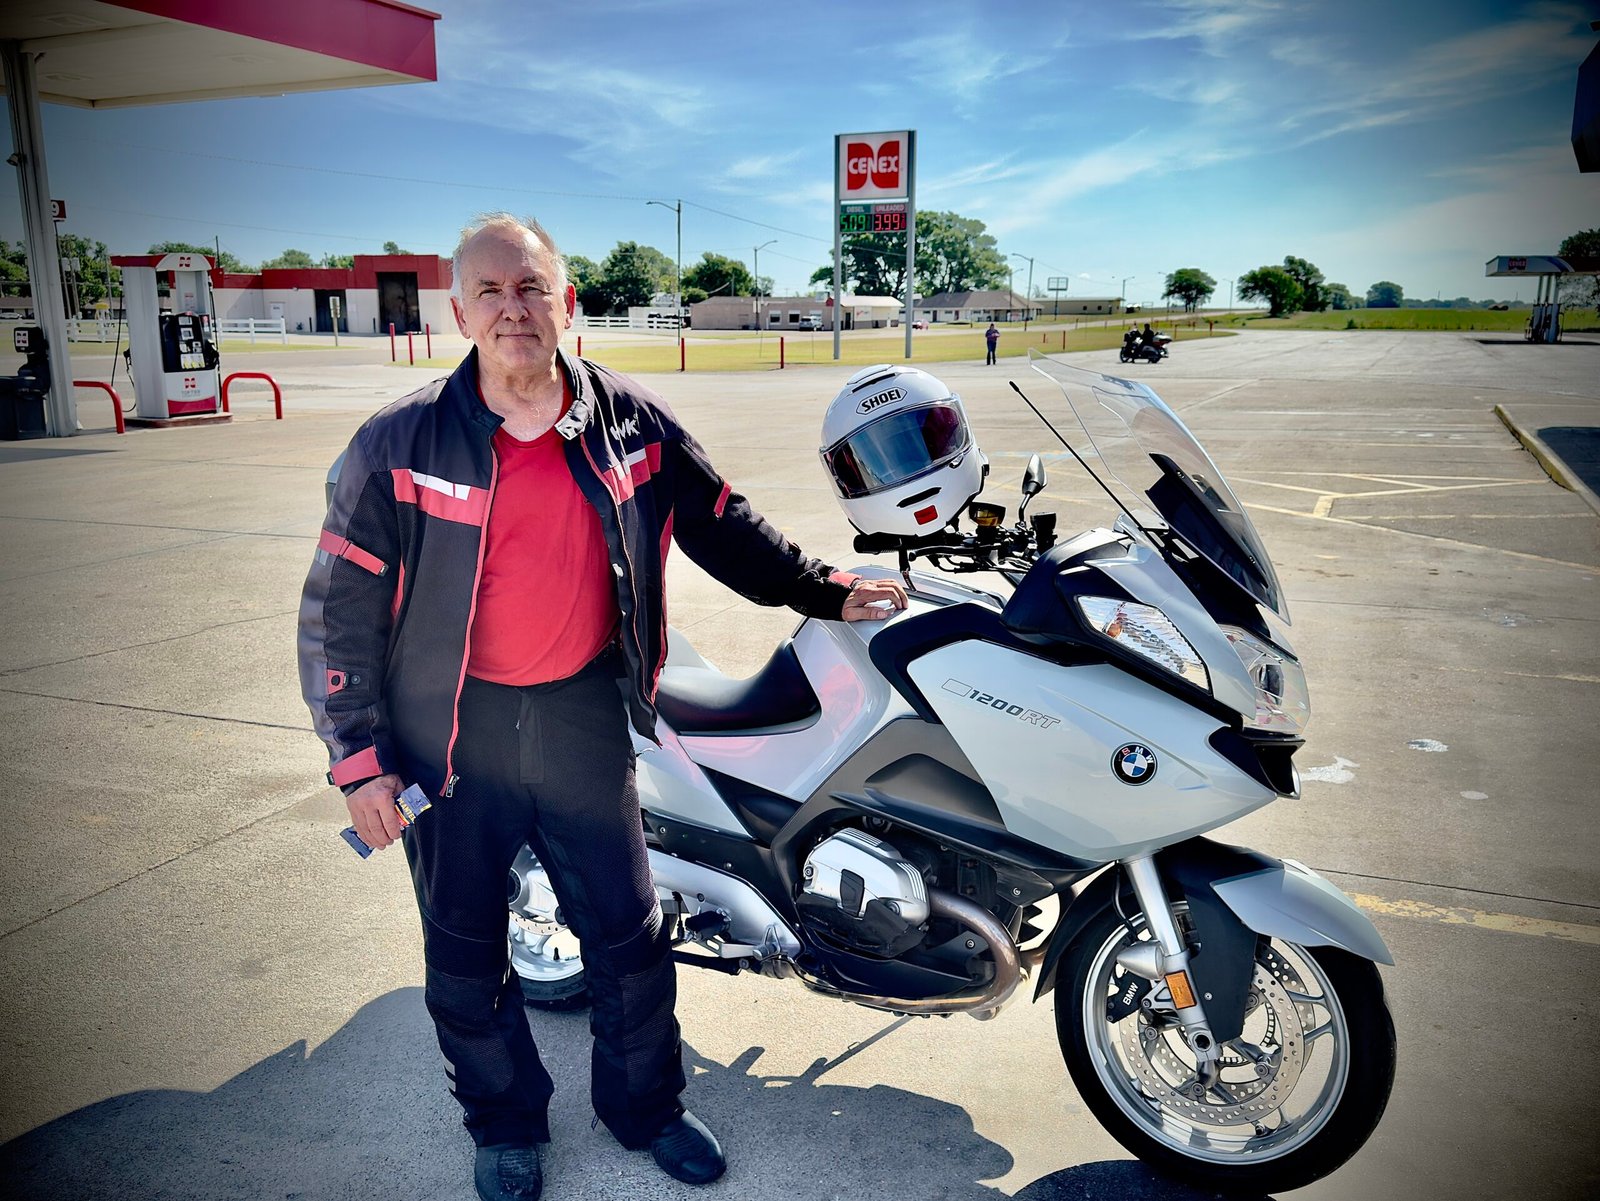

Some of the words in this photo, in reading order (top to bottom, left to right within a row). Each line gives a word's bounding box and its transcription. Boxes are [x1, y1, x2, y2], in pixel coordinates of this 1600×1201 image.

[848, 155, 898, 174] CENEX
[846, 205, 865, 213] DIESEL
[875, 204, 905, 212] UNLEADED
[861, 388, 901, 413] SHOEI
[1121, 746, 1154, 764] BMW
[1122, 982, 1139, 1006] BMW
